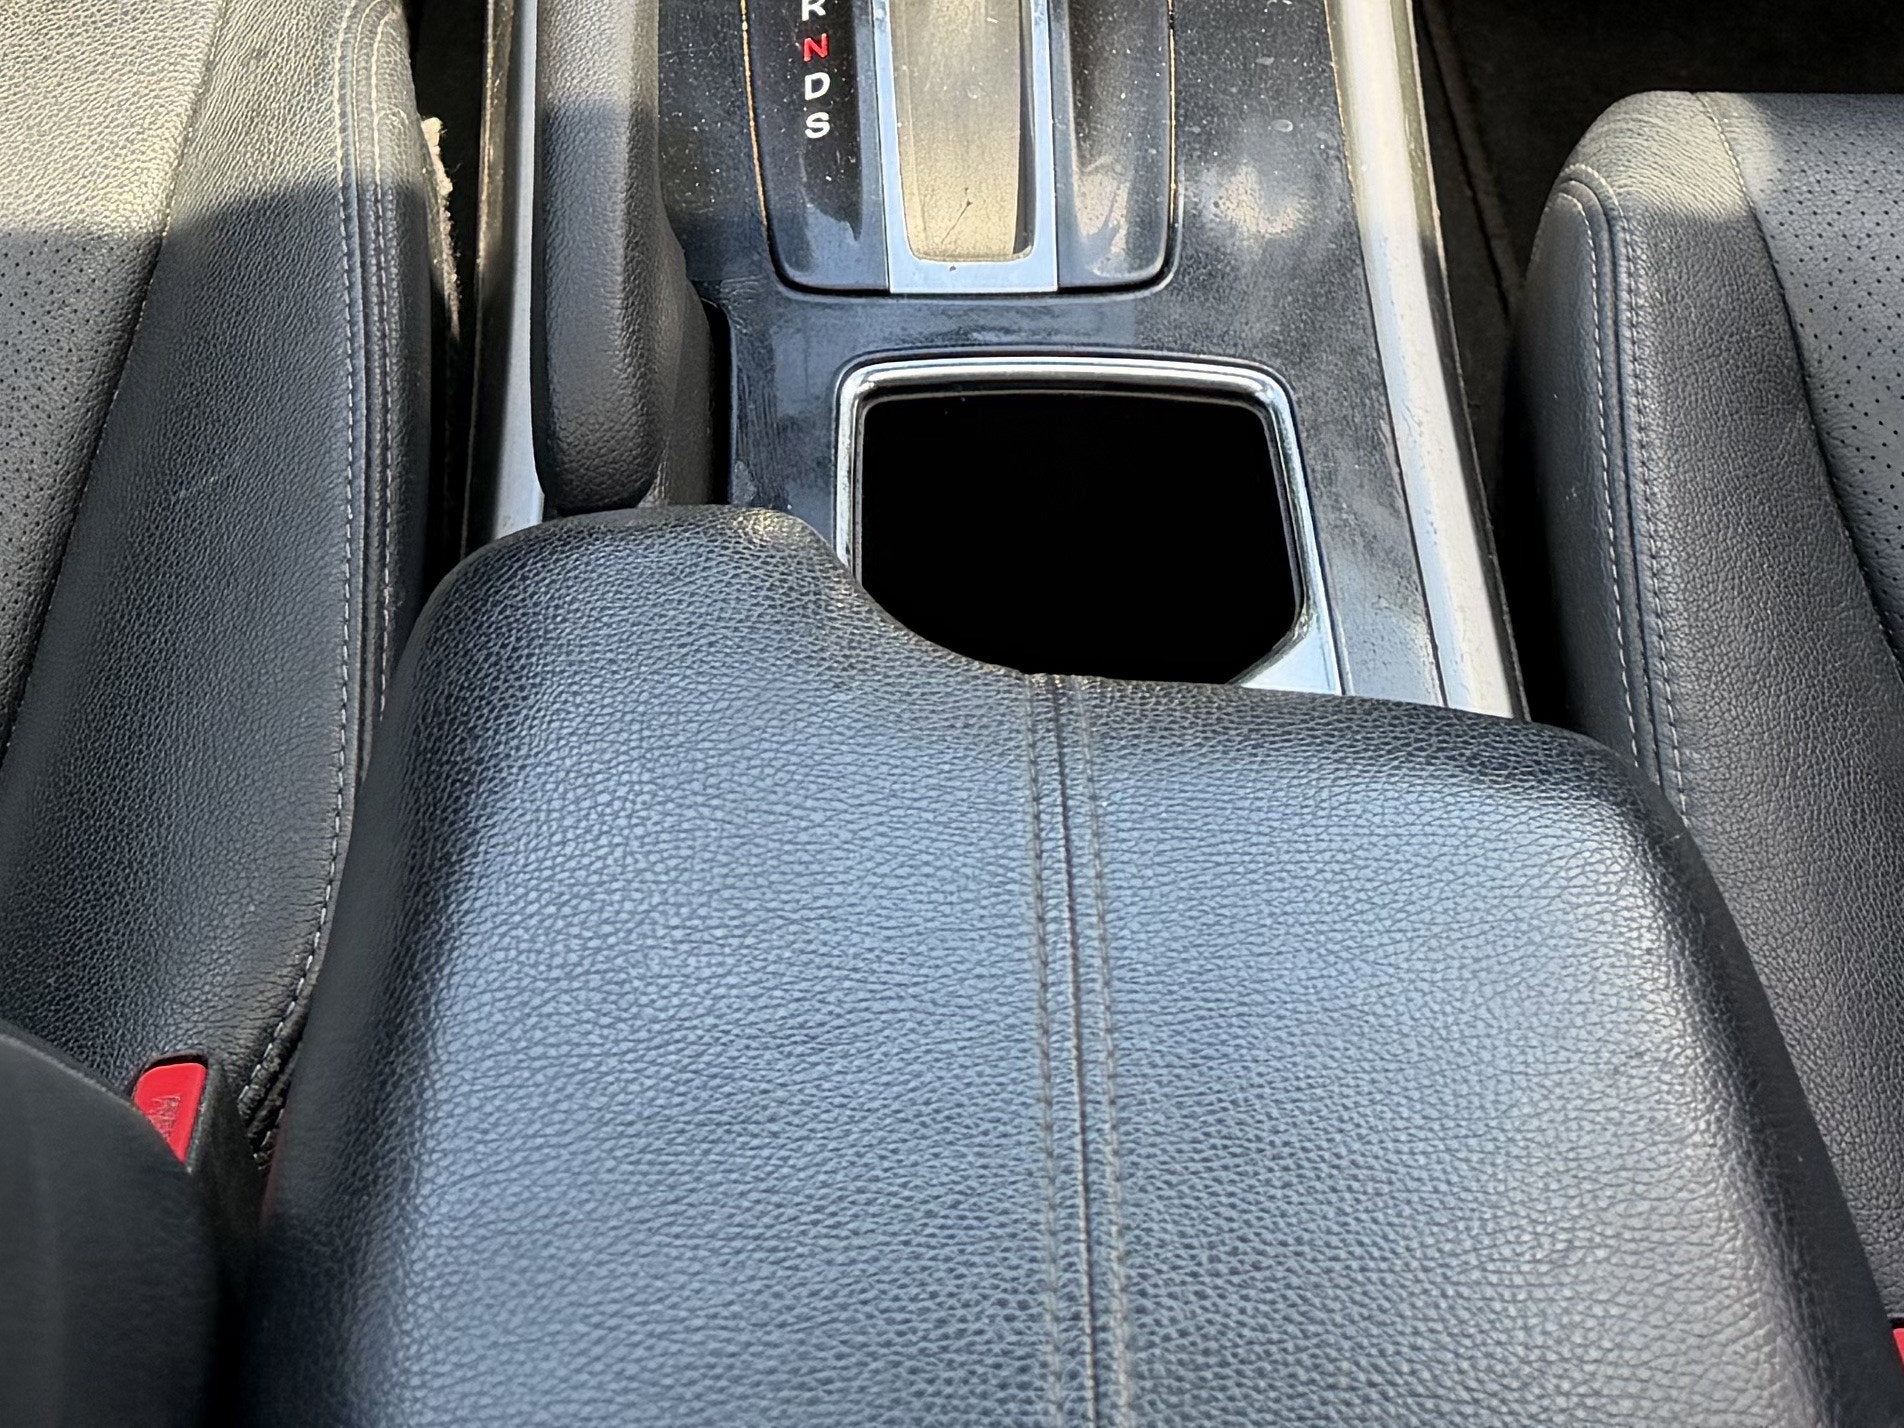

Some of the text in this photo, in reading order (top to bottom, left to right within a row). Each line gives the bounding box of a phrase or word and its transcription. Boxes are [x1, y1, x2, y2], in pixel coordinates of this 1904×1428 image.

[803, 32, 829, 62] N
[804, 71, 831, 101] D
[804, 111, 831, 139] S
